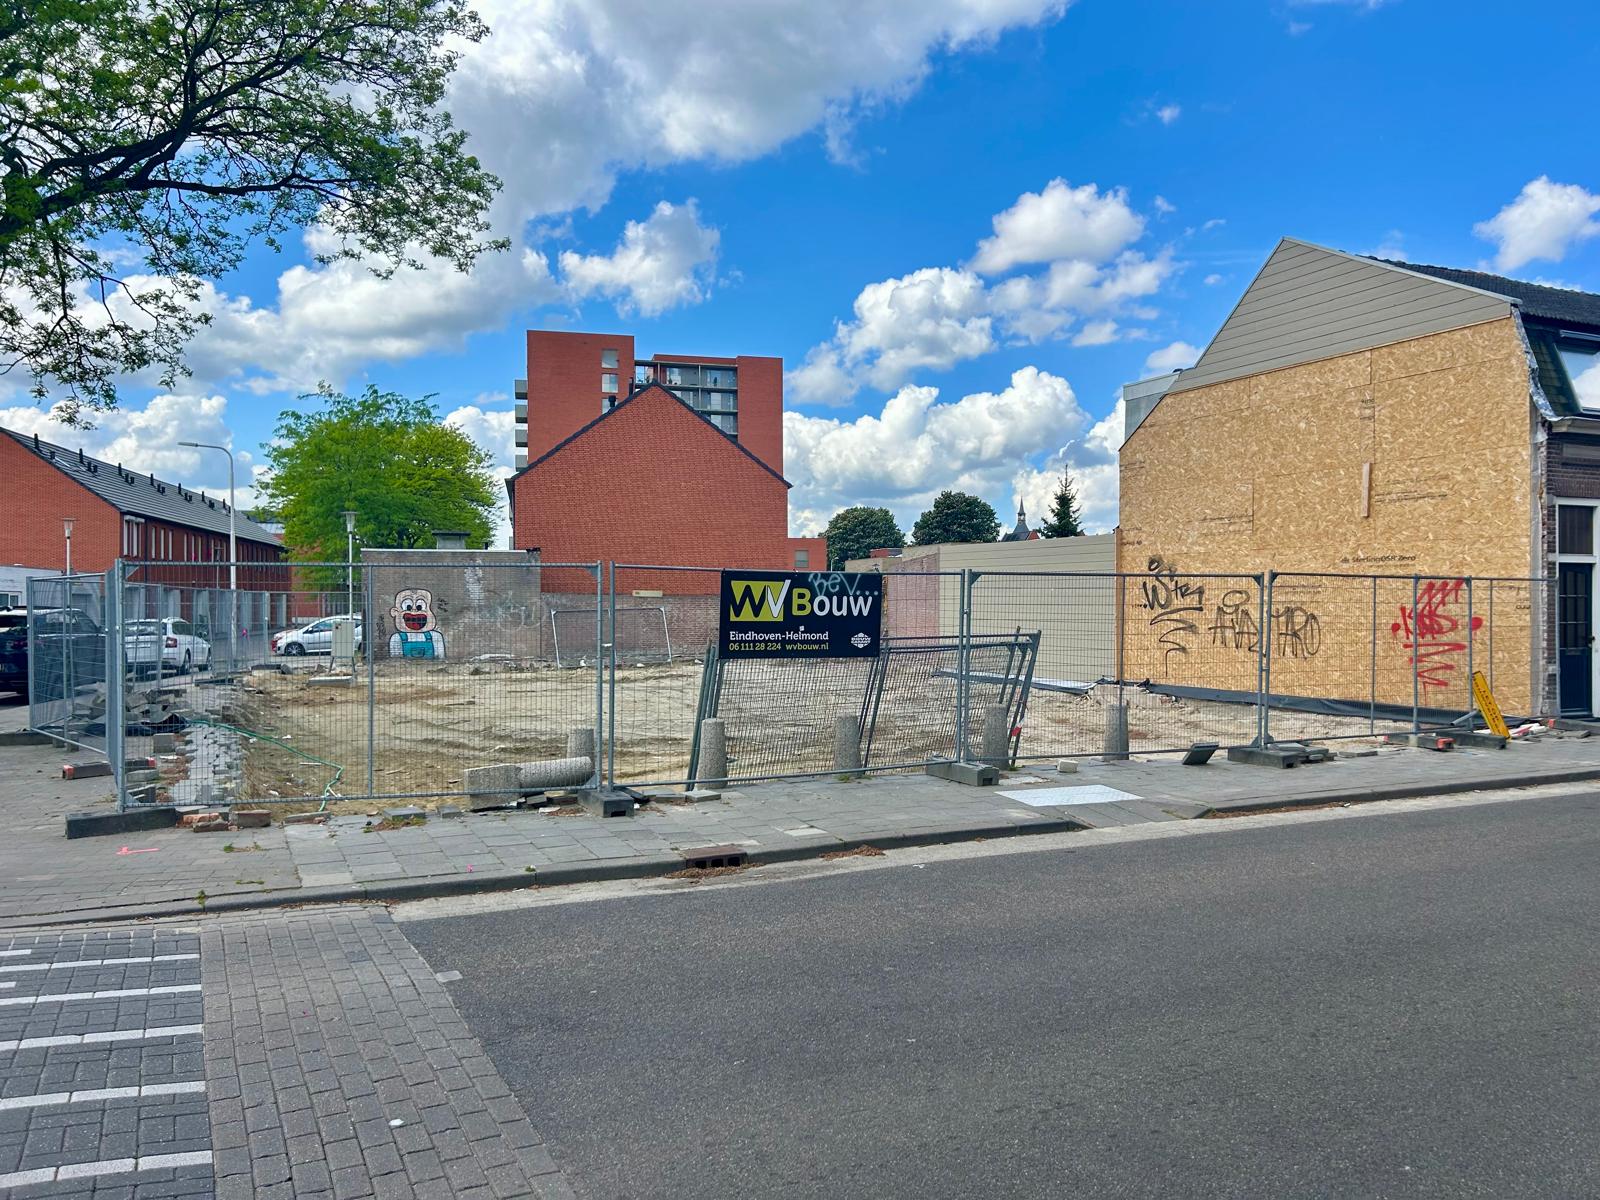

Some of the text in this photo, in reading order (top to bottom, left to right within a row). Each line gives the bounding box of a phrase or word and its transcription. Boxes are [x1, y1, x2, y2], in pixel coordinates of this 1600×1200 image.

[792, 588, 872, 616] Bouw
[729, 631, 829, 640] Eindhoven-Helmond
[729, 642, 829, 651] 06 111 28 224 wvbouw.nl
